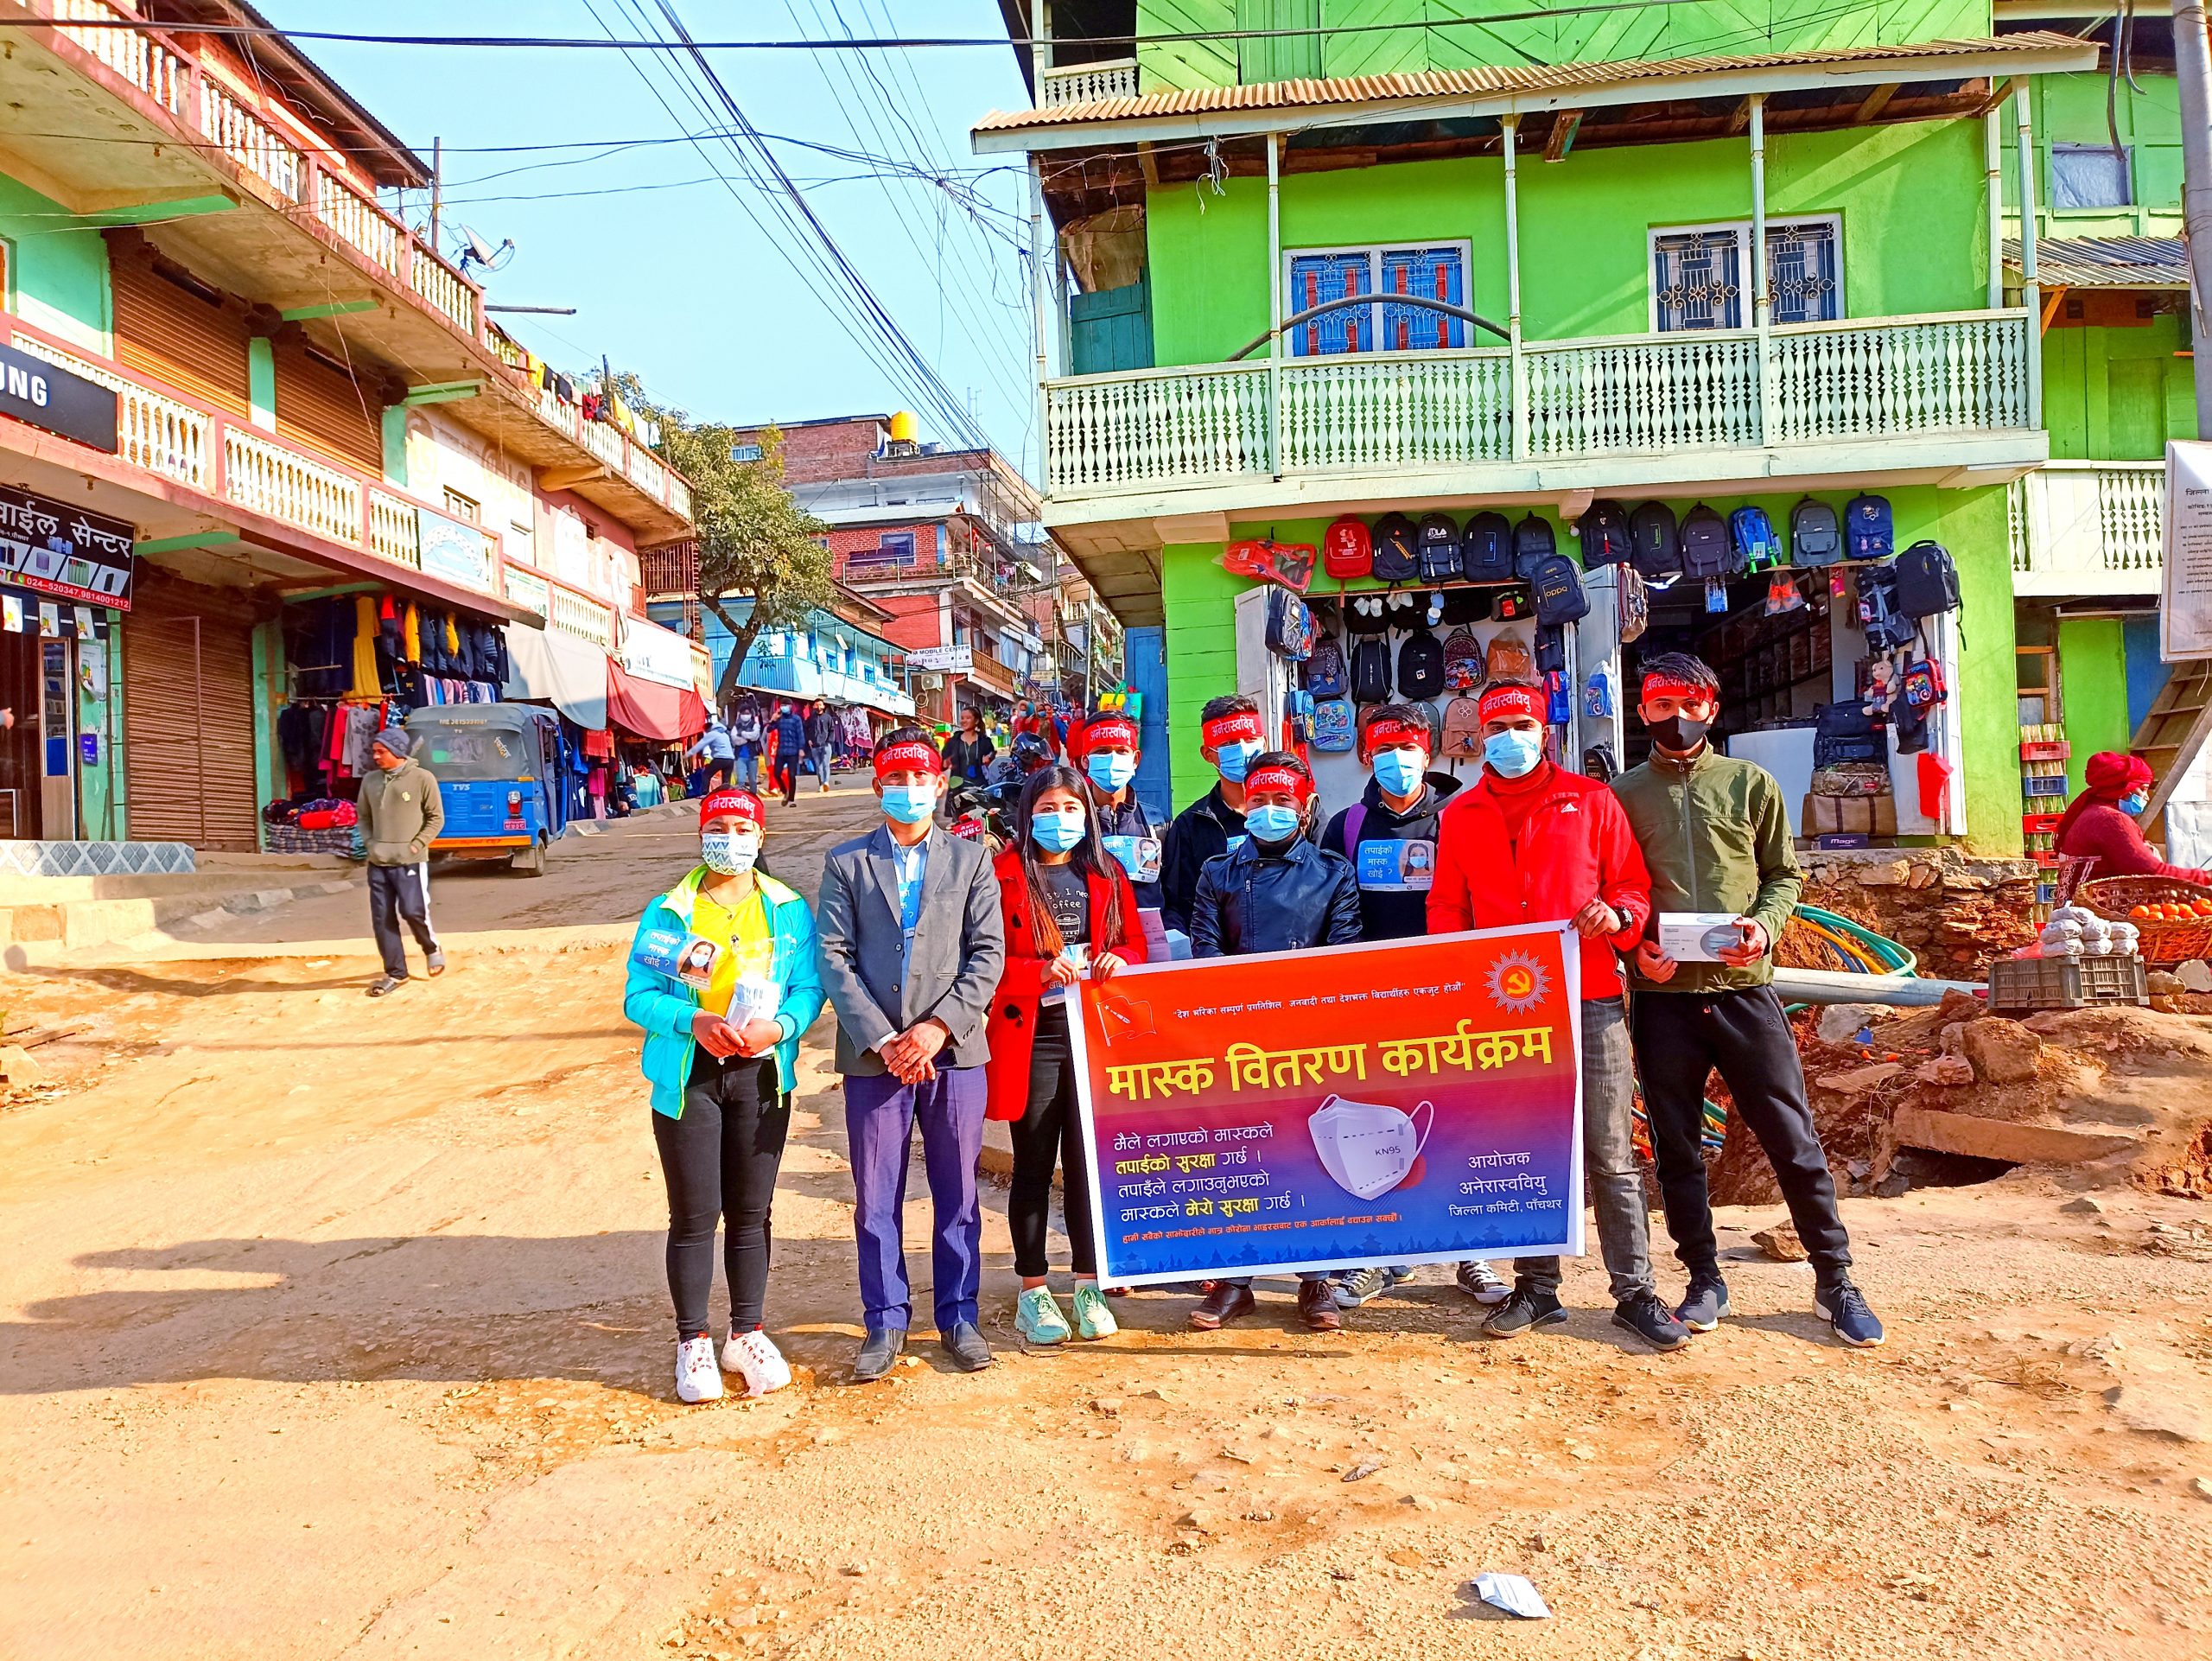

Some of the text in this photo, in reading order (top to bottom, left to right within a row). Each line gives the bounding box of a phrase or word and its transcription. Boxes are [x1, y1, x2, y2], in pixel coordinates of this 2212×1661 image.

[0, 361, 48, 407] NG
[70, 516, 132, 558] सेन्टर
[944, 645, 969, 653] CENTER
[1482, 690, 1531, 713] अनेरास्ववियु
[1090, 723, 1131, 746] अनेरास्ववियु
[1211, 715, 1256, 735] अनेरास्ववियु
[881, 743, 930, 767] अनेरास्ववियु
[1249, 769, 1295, 793] अनेरास्ववियु
[708, 794, 756, 819] अनेरास्ववियु
[1367, 868, 1383, 879] खोई
[643, 954, 661, 968] खोई
[1220, 1002, 1244, 1016] सम्पूर्ण
[1288, 996, 1318, 1007] जनवादी
[1320, 995, 1336, 1005] तथा
[1339, 992, 1368, 1003] देशभक्त
[1413, 984, 1440, 997] एकजुट
[1106, 1018, 1554, 1101] मास्क वितरण कार्यक्रम
[1113, 1121, 1274, 1151] मैले लगाएको मास्कले
[1175, 1152, 1216, 1174] सुरक्षा
[1220, 1146, 1248, 1165] गर्छ
[1375, 1146, 1401, 1156] KN95
[1468, 1149, 1531, 1169] आयोजक
[1172, 1168, 1270, 1194] लगाउनुभएको
[1459, 1172, 1548, 1196] अनेरास्ववियु
[1120, 1200, 1180, 1222] मास्कले
[1185, 1197, 1214, 1217] मेरो
[1217, 1197, 1259, 1218] सुरक्षा
[1263, 1190, 1292, 1210] गर्छ
[1448, 1197, 1562, 1217] जिल्ला कमिटी, पाँचथर
